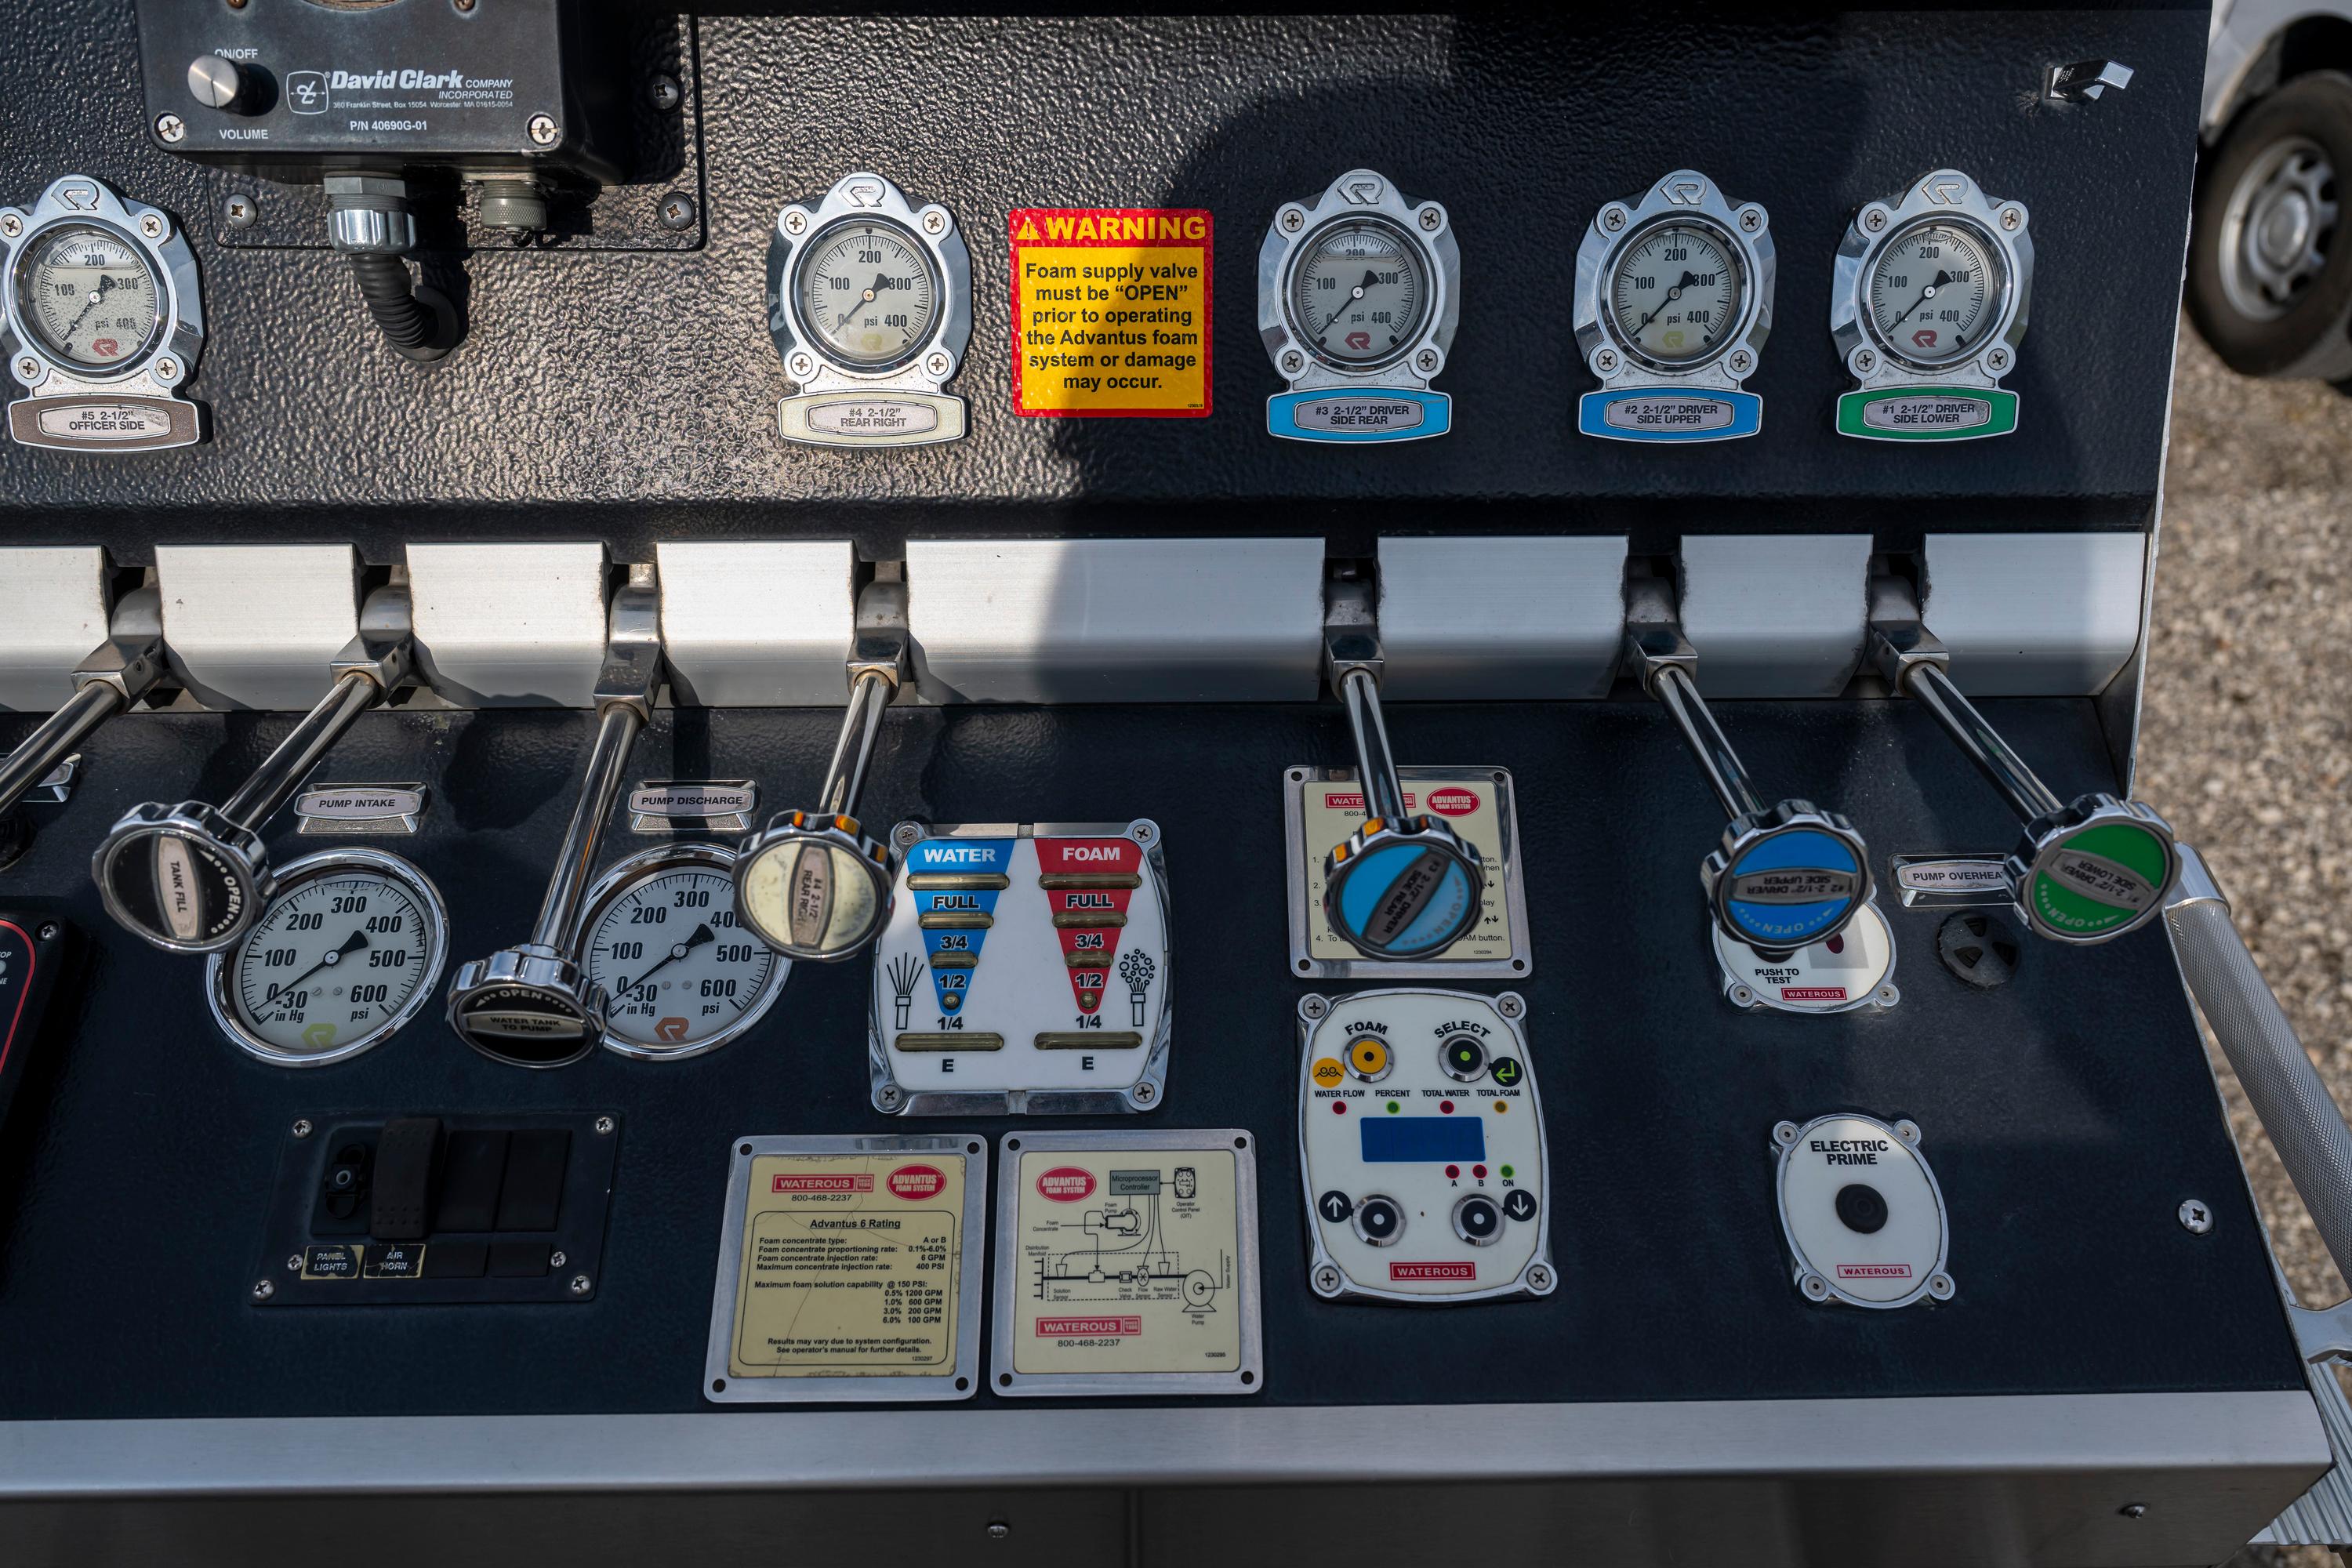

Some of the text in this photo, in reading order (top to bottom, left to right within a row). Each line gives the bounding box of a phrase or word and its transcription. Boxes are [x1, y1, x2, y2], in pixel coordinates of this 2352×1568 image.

[331, 69, 514, 89] David Clark COMPANY
[438, 90, 514, 100] INCORPORATED
[350, 120, 427, 132] P/N 40690G-01
[220, 129, 268, 140] VOLUME
[1045, 216, 1206, 240] WARNING
[858, 250, 881, 263] 200
[1664, 249, 1686, 261] 200
[1919, 247, 1939, 259] 200
[85, 255, 105, 267] 200
[1025, 263, 1198, 282] Foam supply valve
[829, 277, 850, 290] 100
[1316, 278, 1335, 289] 100
[1635, 276, 1655, 289] 100
[1888, 275, 1907, 288] 100
[1036, 285, 1187, 301] must be “OPEN”
[884, 314, 908, 327] 400
[1033, 308, 1192, 326] prior to operating
[1371, 311, 1392, 324] 400
[1687, 310, 1709, 323] 400
[1940, 310, 1959, 322] 400
[1027, 330, 1198, 345] the Advantus foam
[1029, 352, 1196, 370] system or damage
[1063, 376, 1162, 392] may occur.
[82, 411, 95, 420] #5
[849, 408, 862, 417] #4
[1316, 406, 1329, 415] #3
[1369, 405, 1410, 415] DRIVER
[1624, 405, 1638, 414] #2
[1678, 405, 1718, 414] DRIVER
[1882, 405, 1895, 414] #1
[1936, 404, 1975, 413] DRIVER
[69, 420, 145, 430] OFFICER SIDE
[840, 417, 907, 427] REAR RIGHT
[1330, 416, 1388, 425] SIDE REAR
[1637, 415, 1701, 424] SIDE UPPER
[1893, 414, 1959, 423] SIDE LOWER
[318, 798, 396, 808] PUMP INTAKE
[641, 795, 742, 805] PUMP DISCHARGE
[924, 848, 996, 862] WATER
[1062, 847, 1120, 861] FOAM
[1913, 871, 2004, 881] PUMP OVERHEA
[172, 861, 187, 913] TANK FILL
[224, 875, 241, 915] OPEN
[673, 891, 710, 908] 300
[1066, 894, 1113, 908] FULL
[331, 897, 367, 913] 300
[932, 895, 980, 909] FULL
[285, 913, 322, 931] 200
[630, 907, 666, 924] 200
[365, 916, 402, 933] 400
[941, 935, 968, 949] 3/4
[1076, 933, 1103, 948] 3/4
[264, 949, 296, 966] 100
[612, 942, 642, 960] 100
[716, 946, 752, 962] 500
[368, 950, 405, 967] 500
[1755, 968, 1783, 977] PUSH
[939, 974, 966, 989] 1/2
[1076, 973, 1103, 988] 1/2
[1765, 976, 1791, 985] TEST
[350, 985, 387, 1002] 600
[700, 979, 736, 996] 600
[499, 989, 543, 1000] OPEN
[1787, 990, 1841, 999] WATEROUS
[350, 1008, 368, 1022] psi
[702, 1003, 720, 1016] psi
[490, 1016, 561, 1026] WATER TANK
[937, 1016, 964, 1030] 1/4
[1076, 1015, 1102, 1029] 1/4
[1345, 1022, 1388, 1036] FOAM
[1434, 1021, 1491, 1039] SELECT
[942, 1059, 954, 1073] E
[1082, 1057, 1094, 1070] E
[1375, 1089, 1410, 1098] PERCENT
[1421, 1089, 1443, 1098] TOTAL
[1810, 1140, 1889, 1152] ELECTRIC
[1827, 1153, 1878, 1165] PRIME
[781, 1179, 851, 1189] WATEROUS
[893, 1174, 936, 1185] ADVANTUS
[1042, 1177, 1087, 1187] ADVANTUS
[810, 1219, 858, 1229] Advantus
[869, 1219, 901, 1229] Rating
[387, 1251, 403, 1260] AIR
[314, 1262, 347, 1272] LIGHTS
[381, 1261, 407, 1271] HORN
[841, 1263, 875, 1272] injection
[1397, 1266, 1468, 1276] WATEROUS
[1044, 1322, 1117, 1332] WATEROUS
[1058, 1338, 1120, 1348] 800-468-2237
